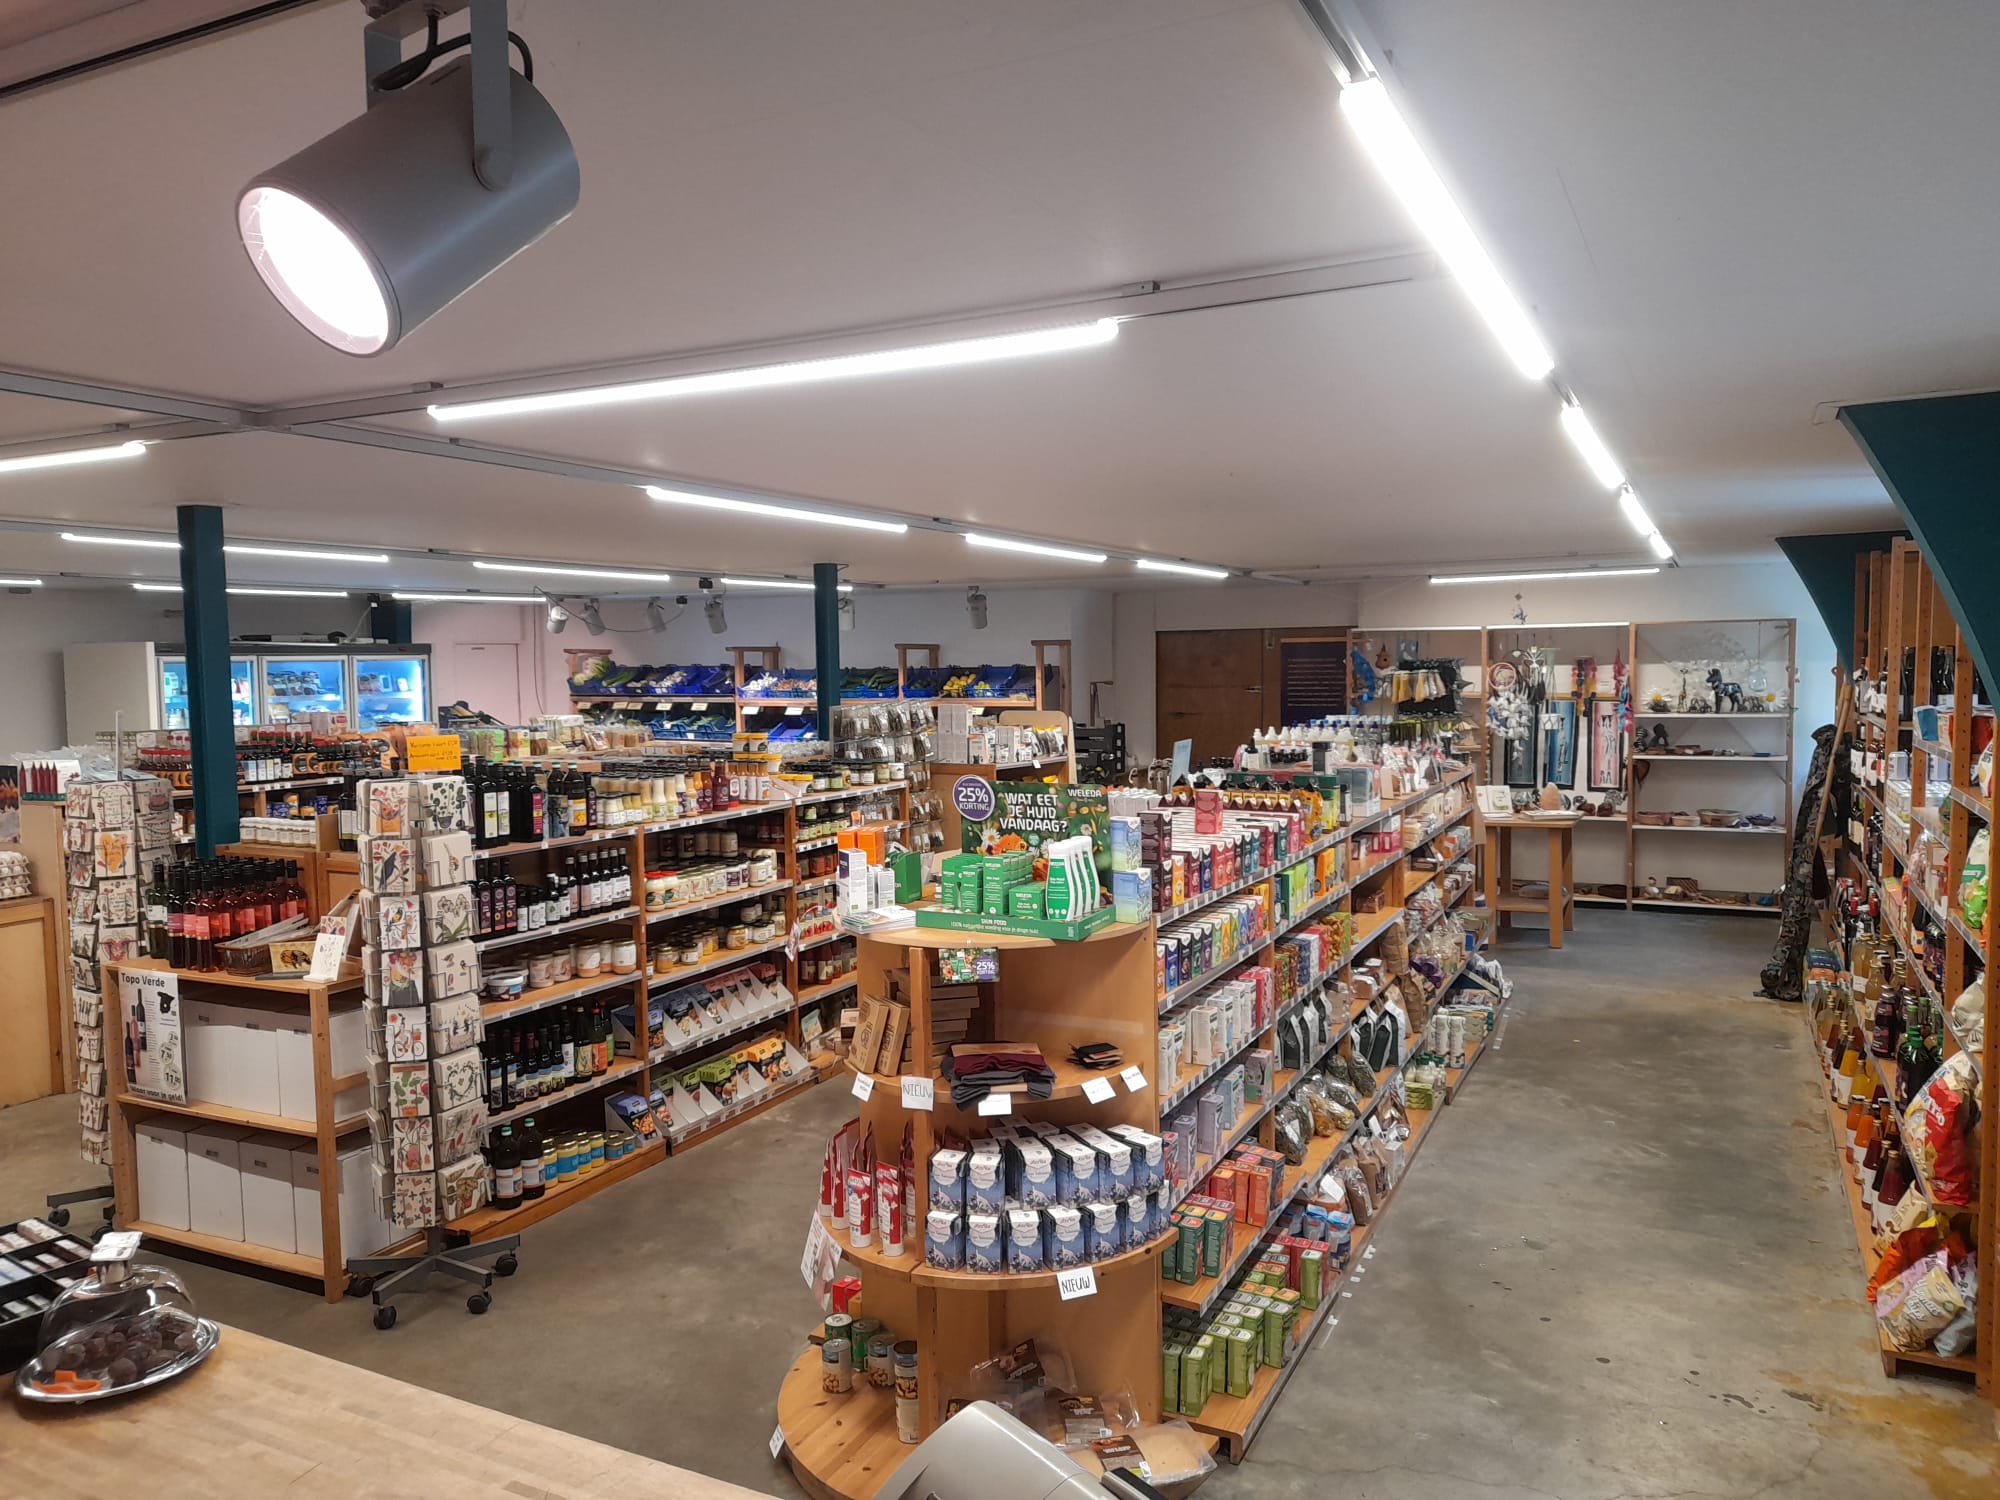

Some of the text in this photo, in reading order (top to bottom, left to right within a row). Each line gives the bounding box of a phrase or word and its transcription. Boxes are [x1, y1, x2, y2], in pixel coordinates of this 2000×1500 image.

[957, 786, 989, 803] 25%
[1004, 792, 1058, 806] WAT EET
[1067, 788, 1102, 798] WELEDA
[959, 802, 990, 811] KORTING
[1008, 805, 1057, 819] JE HUID
[1000, 818, 1068, 833] VANDAAG?
[976, 961, 996, 970] 25%
[121, 973, 165, 987] Topo Verde
[1061, 1274, 1091, 1295] NIEUW
